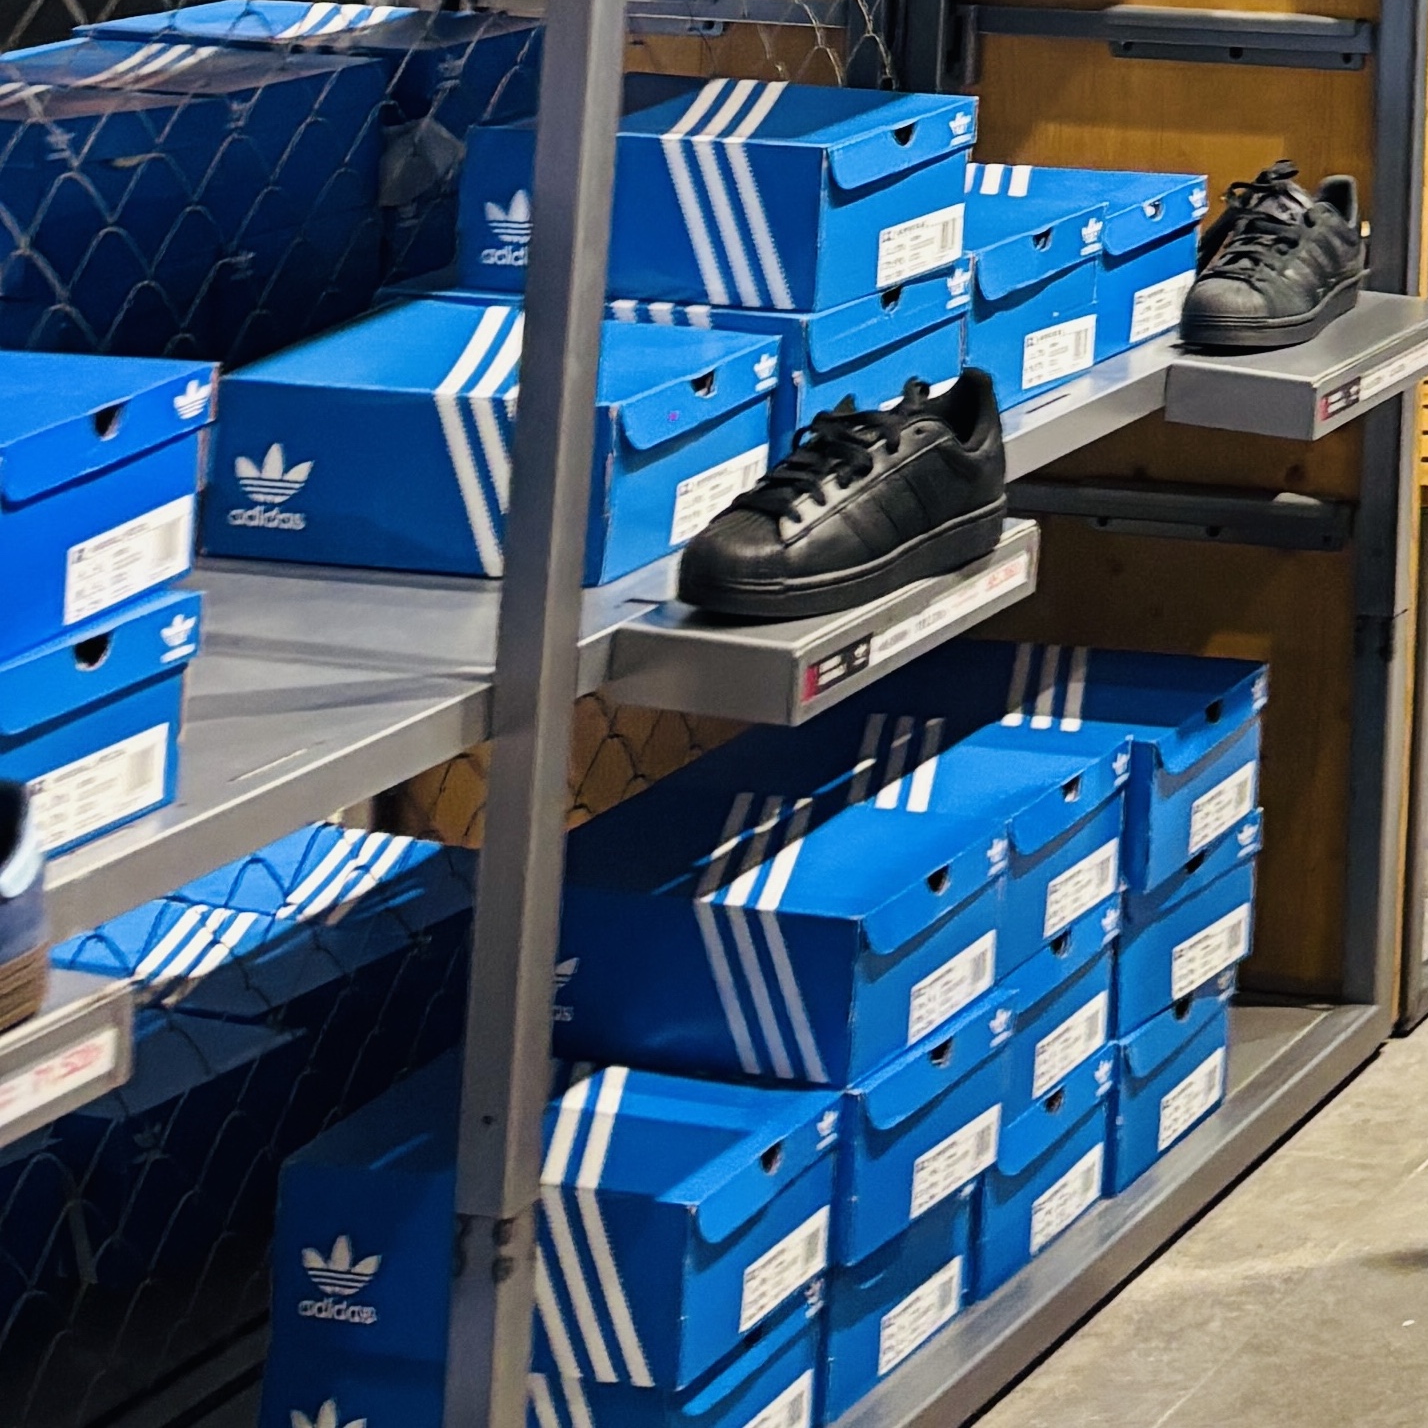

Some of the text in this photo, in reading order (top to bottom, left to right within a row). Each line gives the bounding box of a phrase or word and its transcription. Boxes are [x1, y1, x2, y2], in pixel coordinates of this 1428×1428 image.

[481, 245, 529, 266] adid
[228, 504, 307, 531] adidas
[298, 1296, 378, 1325] adidas
